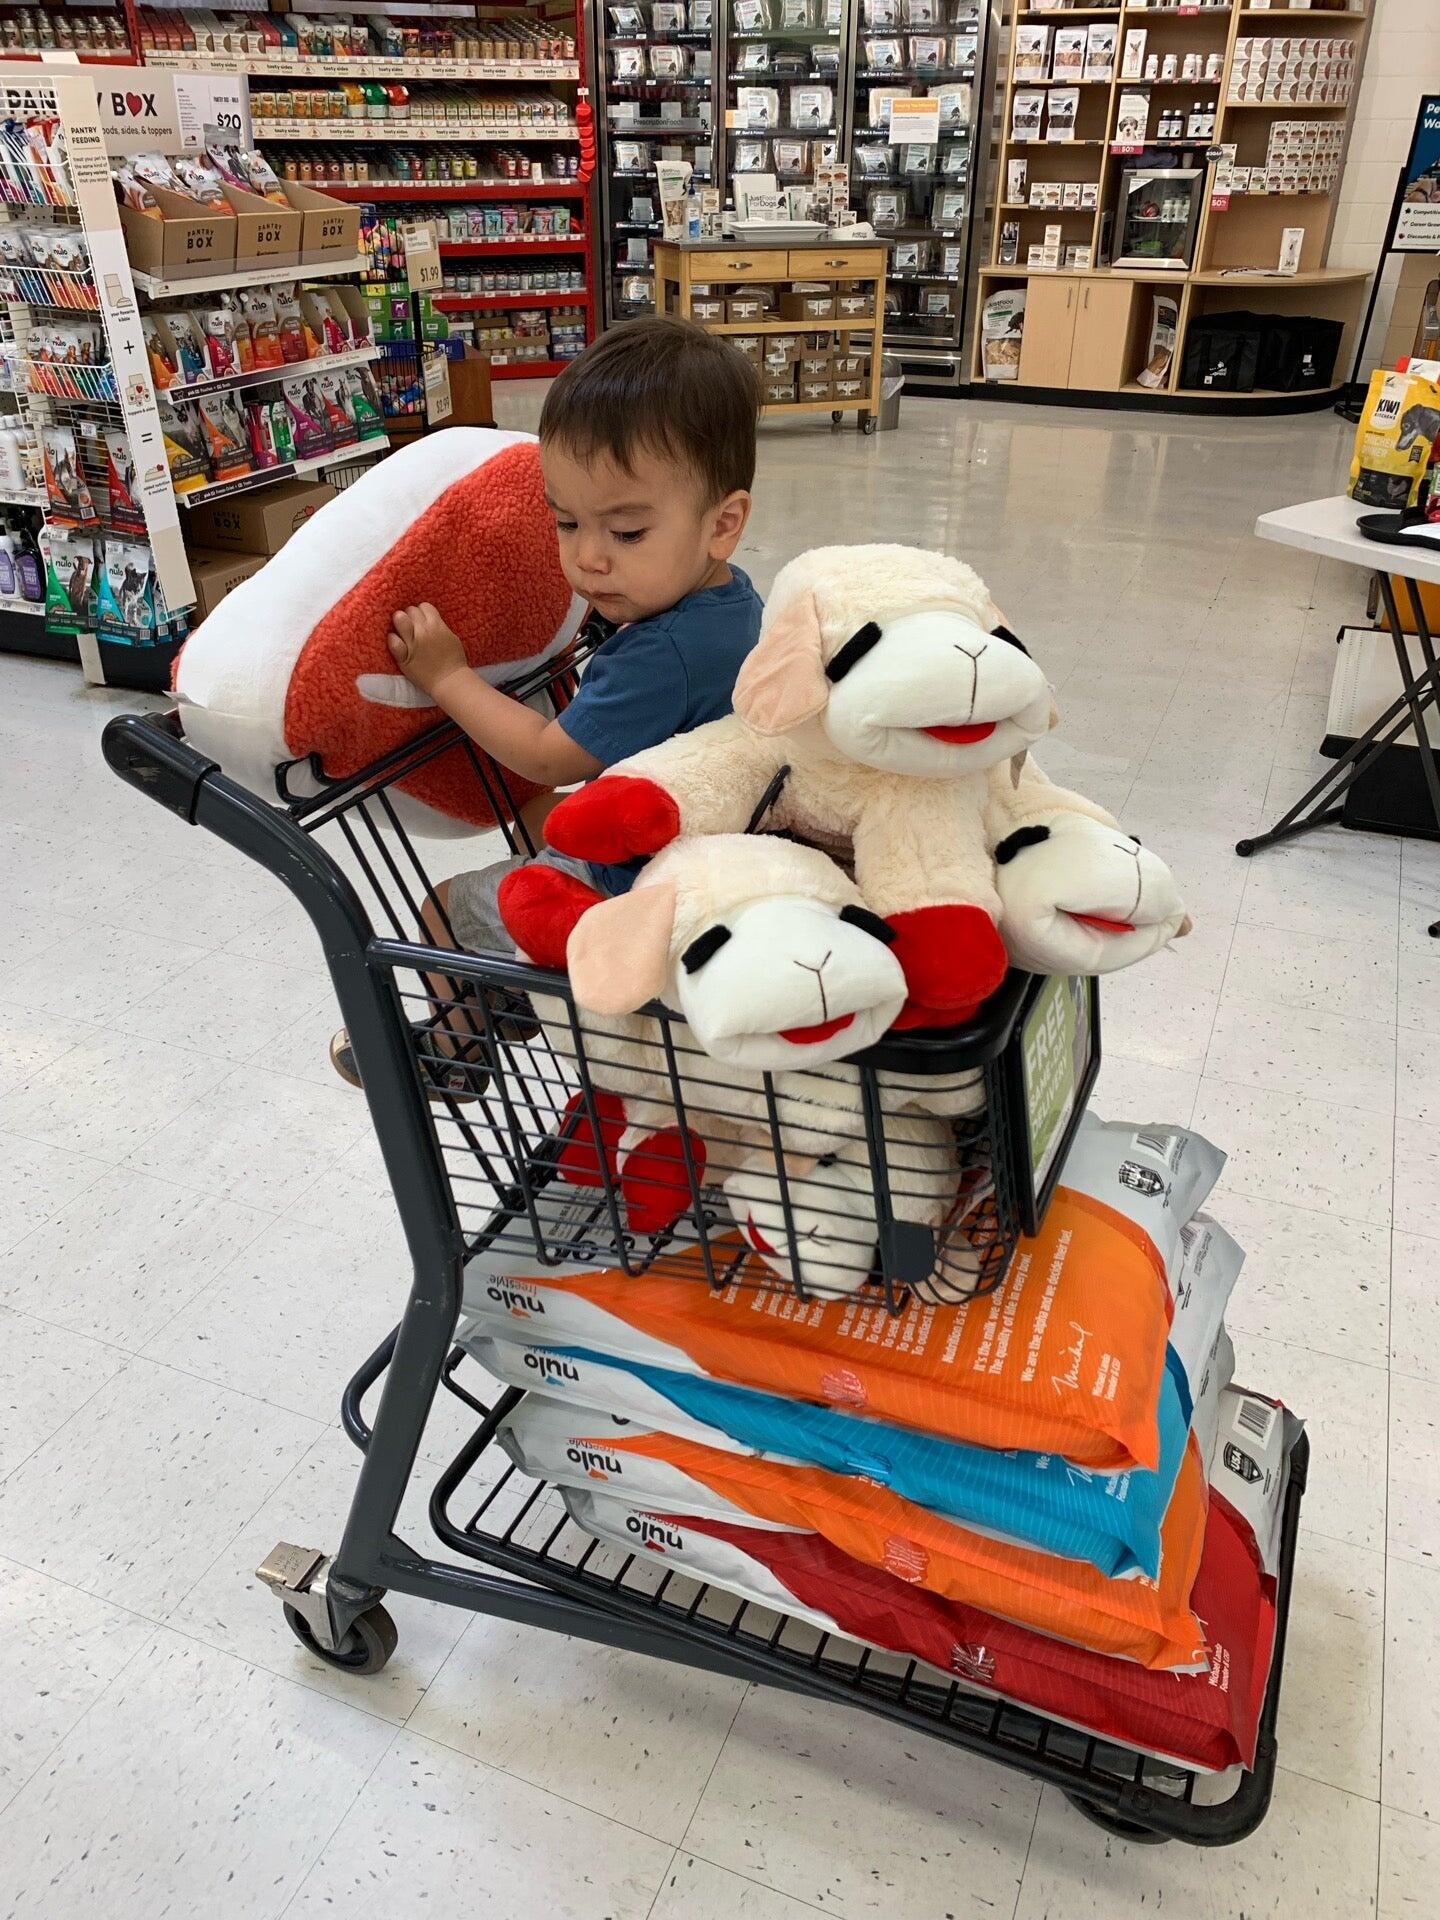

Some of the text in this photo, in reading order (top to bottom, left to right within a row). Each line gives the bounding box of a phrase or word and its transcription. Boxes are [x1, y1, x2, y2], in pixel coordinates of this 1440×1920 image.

[70, 126, 98, 134] PANTRY
[141, 126, 147, 134] &
[148, 126, 173, 137] toppers
[72, 136, 100, 144] FEEDING
[257, 223, 282, 231] PANTRY
[322, 218, 344, 226] PANTRY
[187, 228, 214, 237] PANTRY
[257, 231, 281, 242] BOX
[322, 226, 343, 236] BOX
[187, 237, 213, 249] BOX
[420, 266, 440, 283] $1.99
[288, 387, 301, 396] nulo
[321, 380, 334, 388] nulo
[205, 405, 218, 413] nulo
[1376, 398, 1401, 416] KIWI
[1374, 412, 1397, 420] KITCHENS
[112, 451, 126, 461] nulo
[214, 519, 241, 530] BOX
[55, 560, 72, 568] nulo
[109, 568, 124, 577] nulo
[1027, 984, 1066, 1090] FREE
[1033, 1053, 1067, 1138] DELIVERY
[1054, 1244, 1068, 1261] their
[1017, 1253, 1032, 1273] bowl.
[1048, 1262, 1063, 1285] decide
[1013, 1271, 1028, 1293] every
[1045, 1284, 1056, 1297] we
[487, 1286, 546, 1314] nulo
[1040, 1296, 1052, 1312] and
[989, 1306, 1000, 1320] we
[1004, 1303, 1016, 1316] life
[837, 1319, 852, 1336] Like
[852, 1320, 869, 1340] they
[983, 1320, 997, 1340] milk
[1033, 1310, 1048, 1335] alpha
[866, 1334, 879, 1344] To
[881, 1319, 901, 1348] To seek
[902, 1322, 916, 1342] gain
[896, 1342, 909, 1352] To
[942, 1325, 964, 1364] Nutrition
[978, 1340, 992, 1357] the
[996, 1328, 1013, 1358] quality
[1029, 1334, 1042, 1351] the
[911, 1346, 925, 1356] To
[1026, 1350, 1038, 1366] are
[524, 1354, 580, 1382] nulo
[973, 1357, 987, 1372] It's
[988, 1359, 1003, 1375] The
[1020, 1366, 1035, 1382] We
[1104, 1376, 1118, 1402] Founder
[567, 1448, 622, 1474] nulo
[1035, 1455, 1050, 1469] We
[1231, 1449, 1242, 1471] USA
[626, 1516, 683, 1550] nulo
[1208, 1660, 1220, 1686] Michael
[1220, 1666, 1230, 1692] Founder
